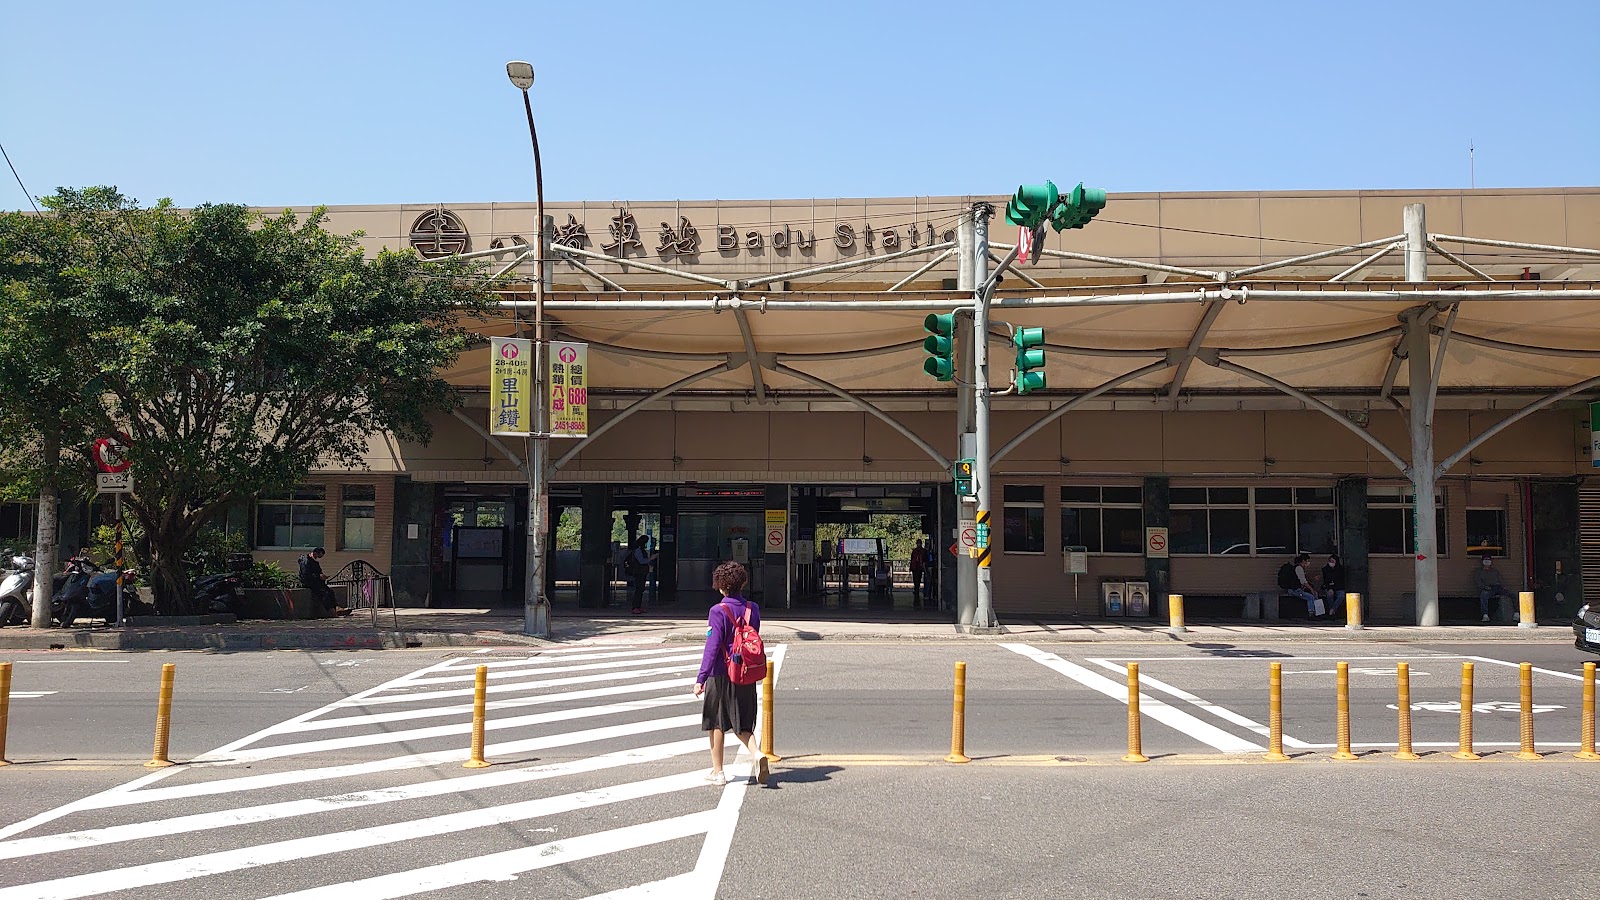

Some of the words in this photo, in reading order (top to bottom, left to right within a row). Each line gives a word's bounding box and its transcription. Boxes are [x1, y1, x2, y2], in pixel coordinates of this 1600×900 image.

[717, 223, 813, 250] Badu
[833, 221, 958, 250] Statio
[499, 377, 521, 428] 里山鑽
[102, 475, 128, 483] 0-24
[963, 463, 970, 475] 9
